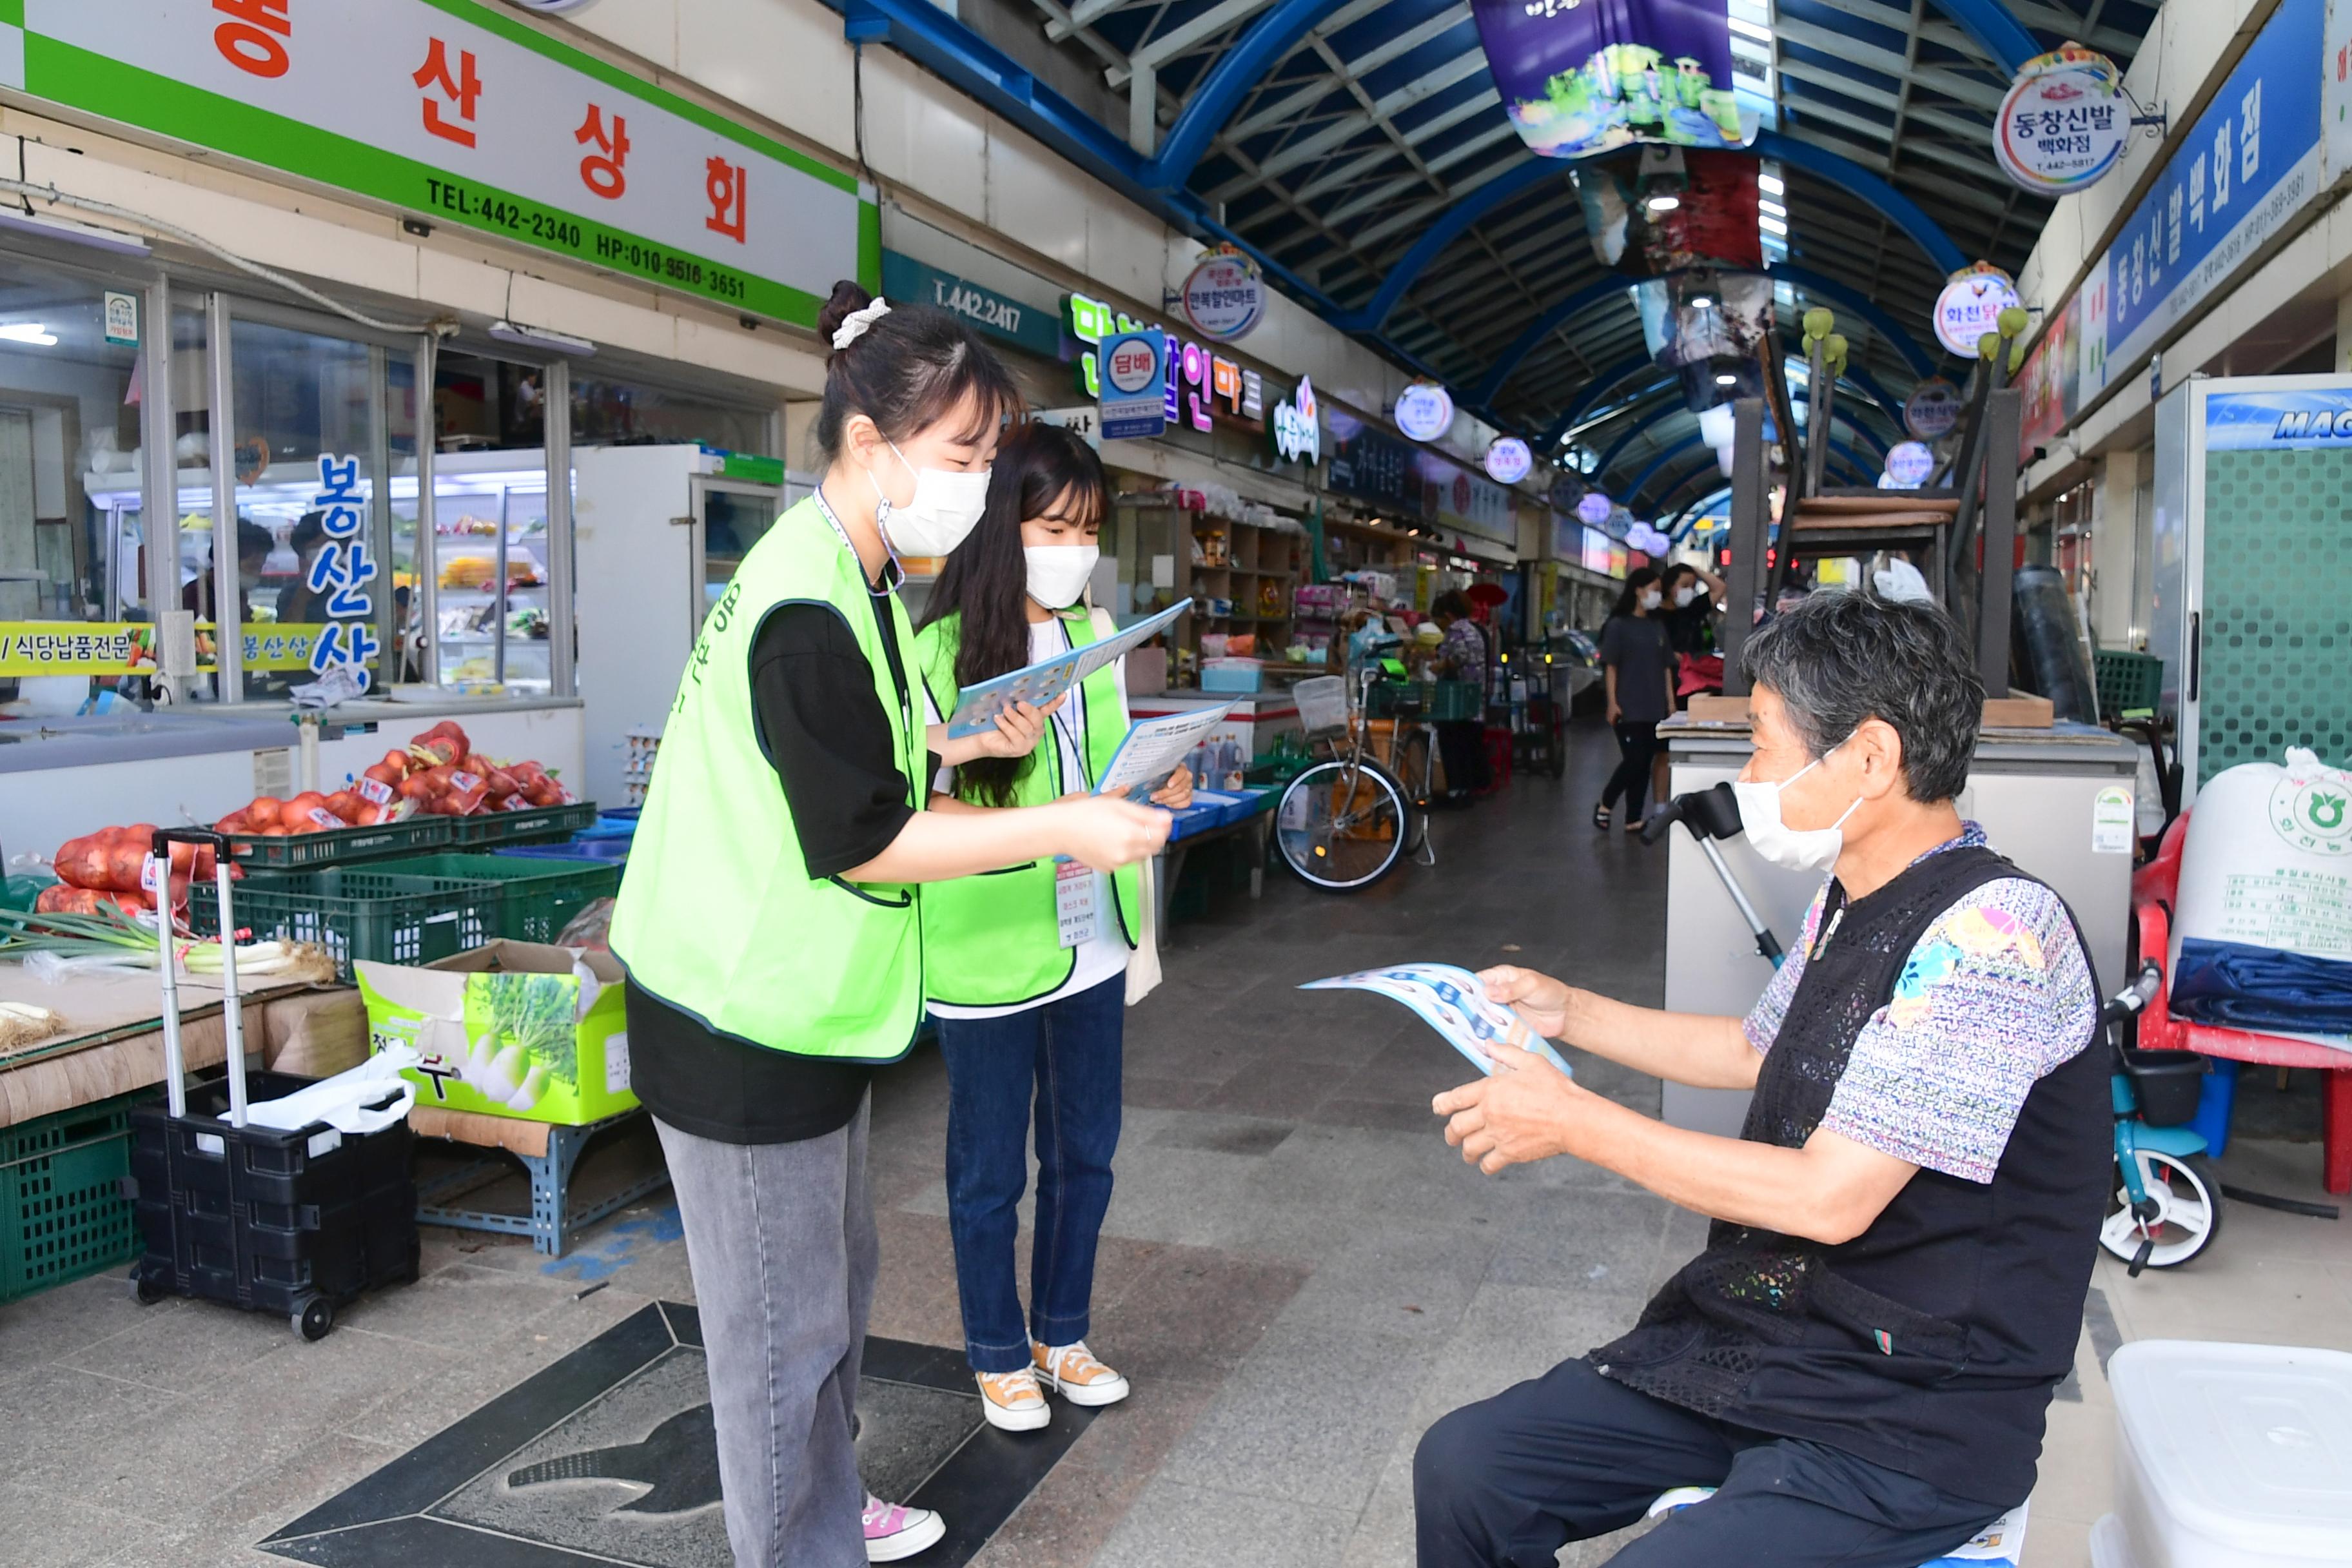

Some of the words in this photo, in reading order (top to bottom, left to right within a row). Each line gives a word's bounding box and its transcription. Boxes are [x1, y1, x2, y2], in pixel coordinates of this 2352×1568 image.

[2014, 105, 2115, 139] 동창신발
[2038, 135, 2090, 155] 백화점
[1115, 352, 1151, 375] 담배
[15, 634, 130, 662] 식당납품전문
